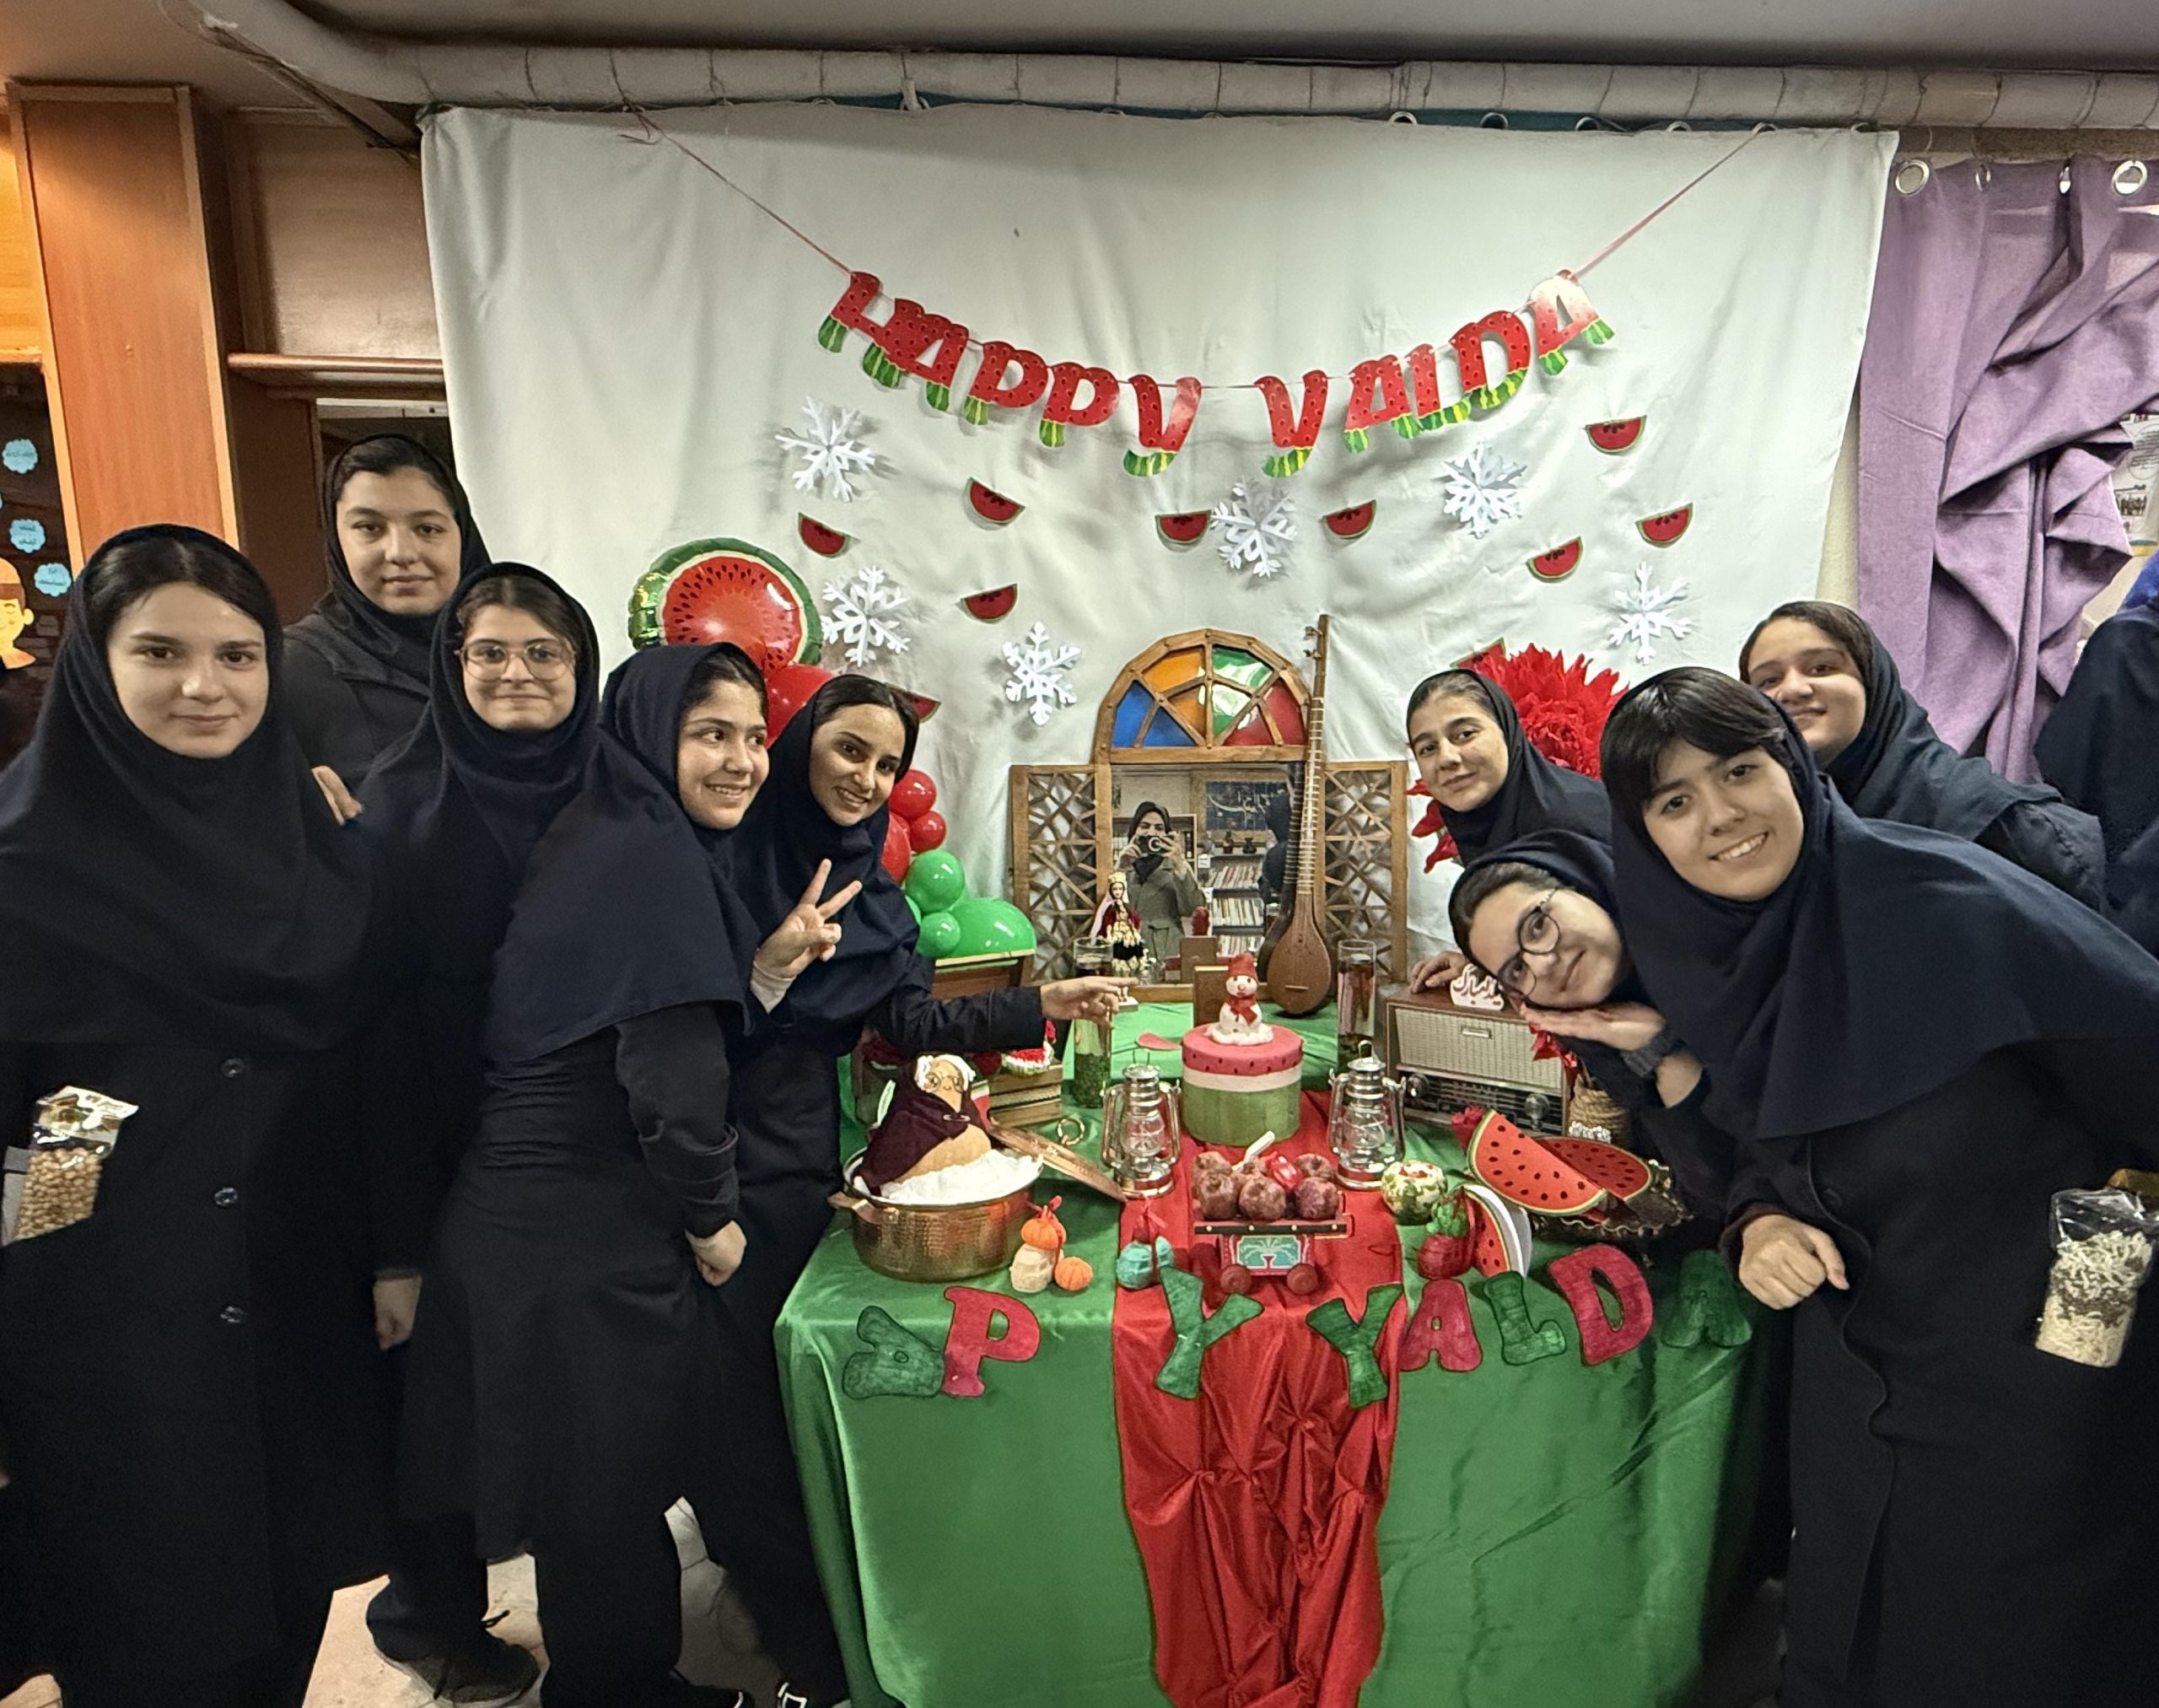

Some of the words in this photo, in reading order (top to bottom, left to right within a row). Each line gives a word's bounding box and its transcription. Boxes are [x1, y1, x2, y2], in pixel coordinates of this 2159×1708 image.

[817, 271, 1203, 477] HAPPY
[1254, 269, 1616, 478] YALDA
[1306, 1243, 1753, 1409] YALDA
